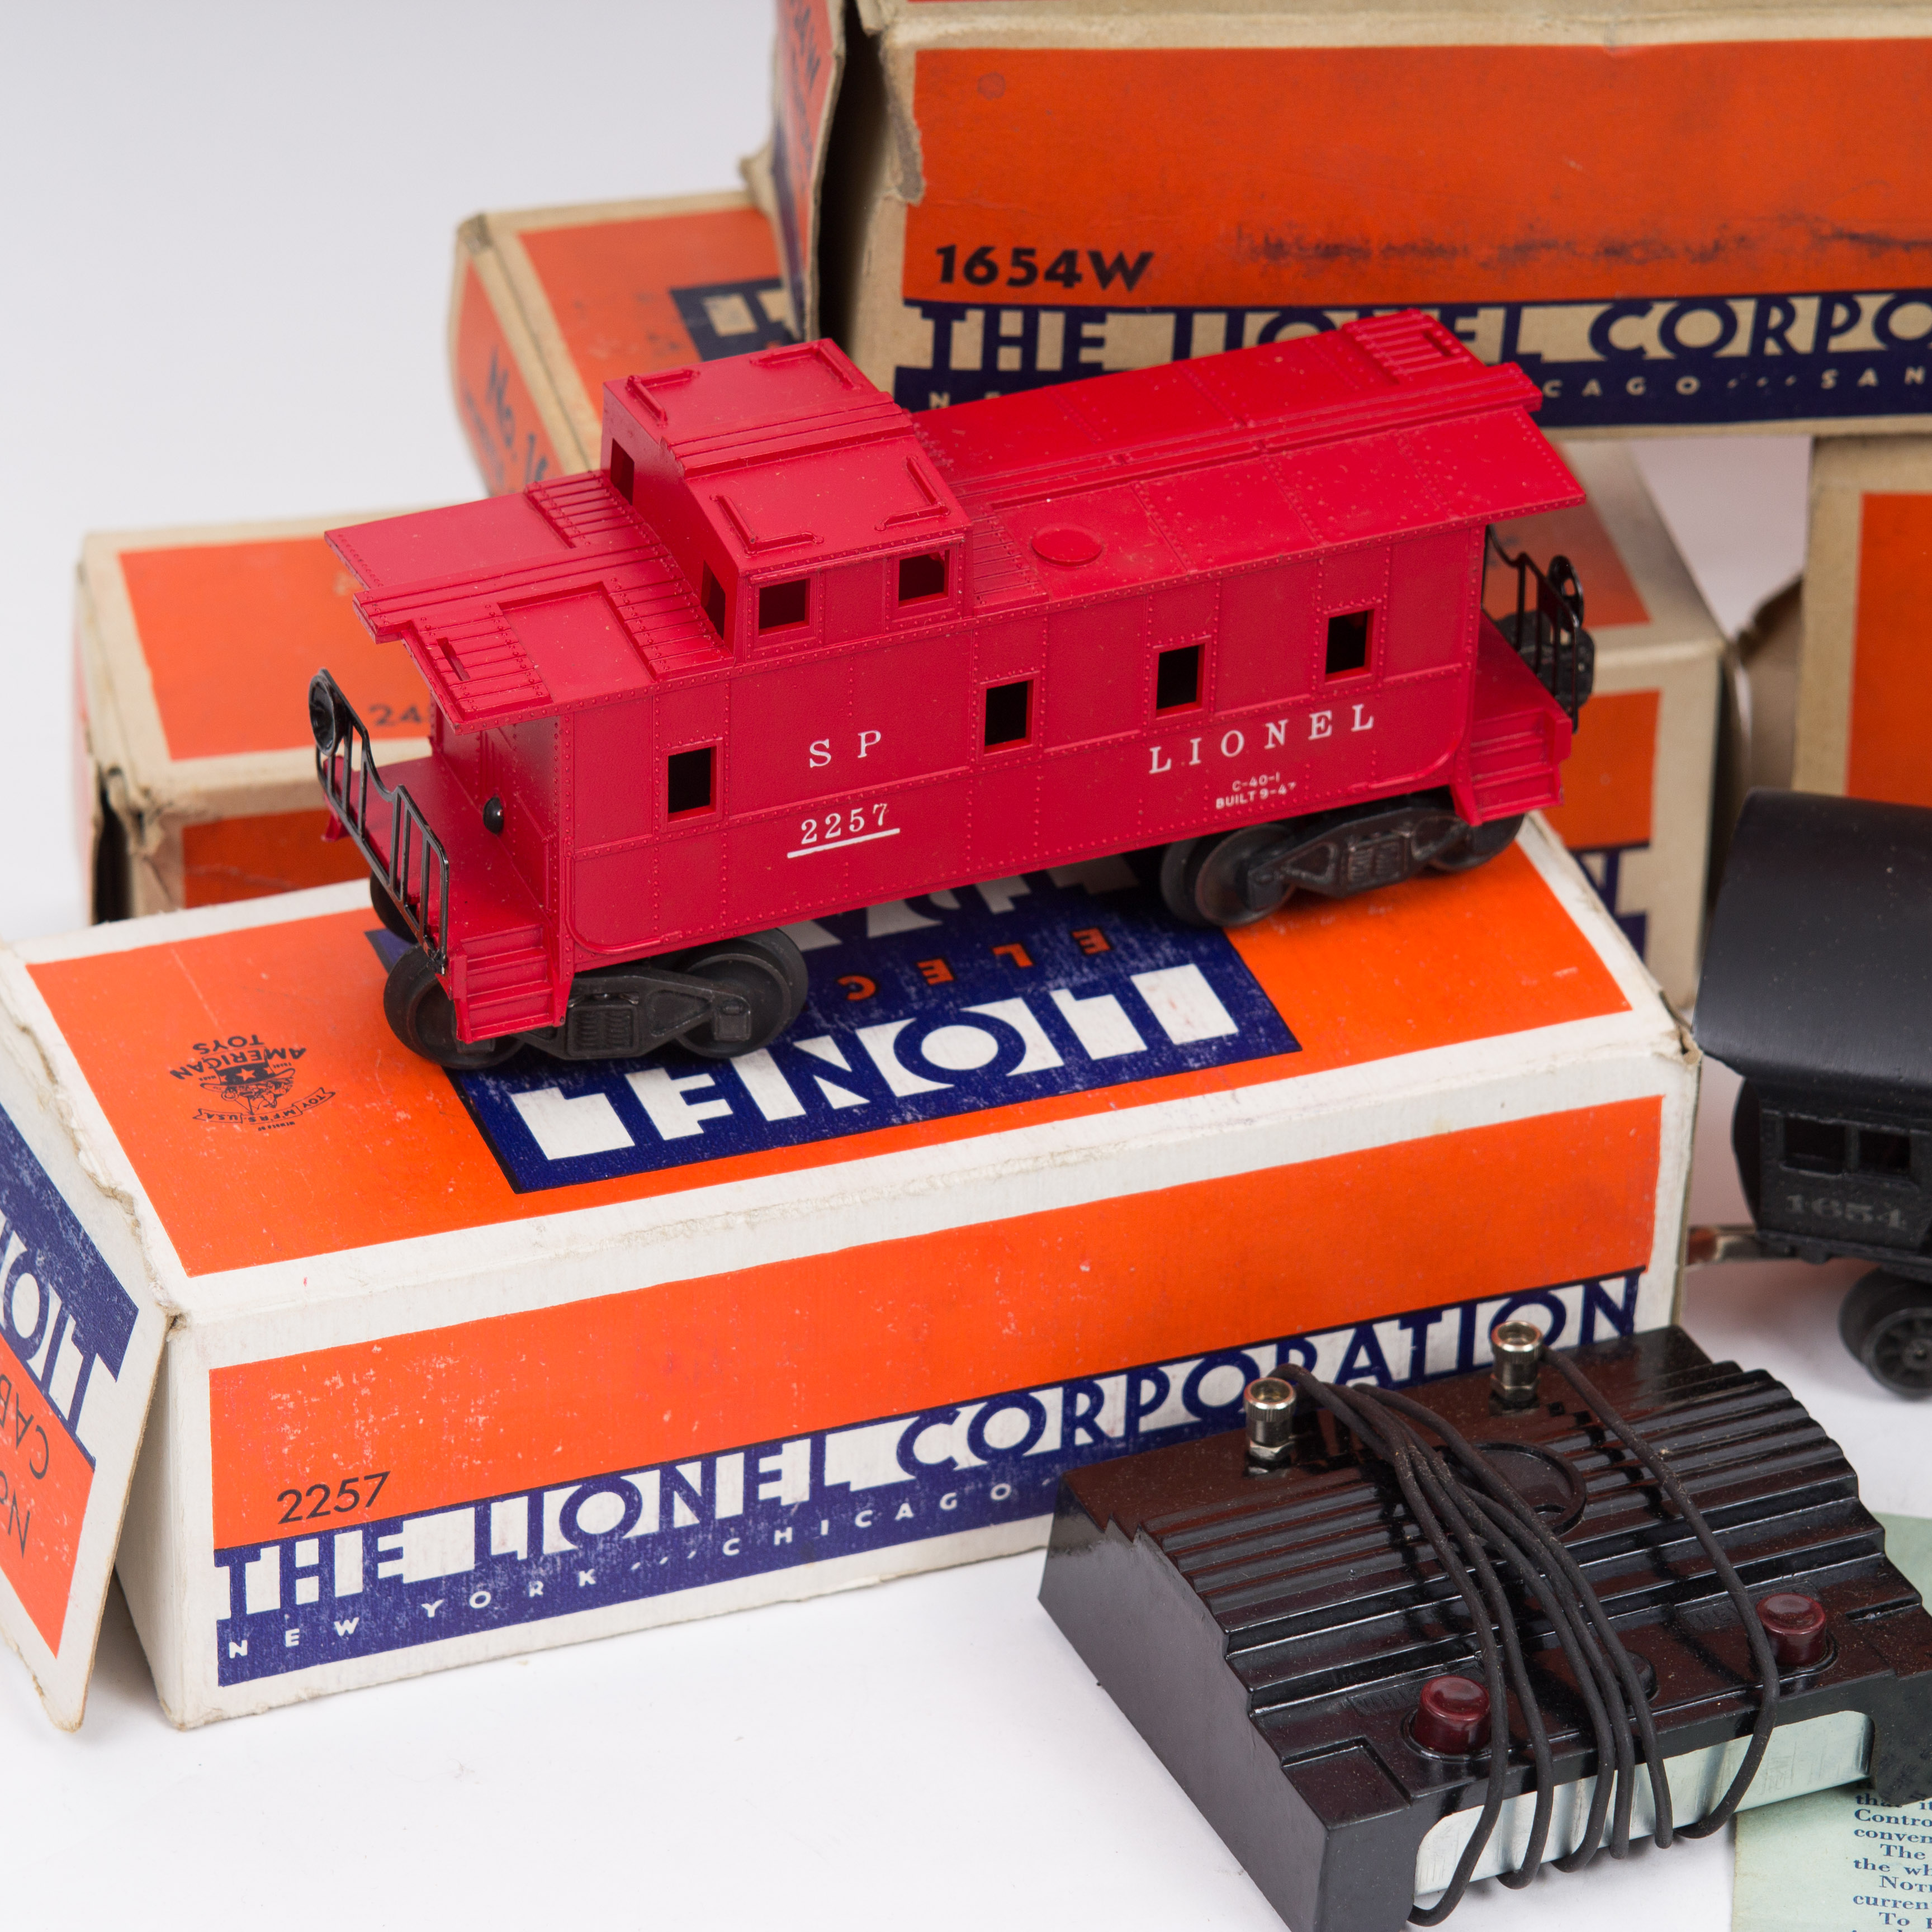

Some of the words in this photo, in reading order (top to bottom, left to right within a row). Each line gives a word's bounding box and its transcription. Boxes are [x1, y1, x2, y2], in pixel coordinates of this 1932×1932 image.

[936, 244, 1154, 292] 1654W
[920, 304, 1107, 372] THE
[1149, 704, 1374, 774] LIONEL
[1215, 790, 1256, 810] BUILT
[801, 803, 887, 845] 2257
[193, 1034, 265, 1054] TOYS
[559, 970, 1191, 1149] LIONEL
[169, 1047, 307, 1079] AMERICAN
[301, 1094, 326, 1109] TOY
[277, 1470, 391, 1525] 2257
[215, 1522, 404, 1617] THE
[474, 1432, 851, 1572] LIONEL
[229, 1617, 359, 1659] NEW
[422, 1569, 596, 1618] YORK
[722, 1483, 1012, 1556] CHICAGO
[1853, 1858, 1890, 1872] the
[1880, 1844, 1926, 1860] The
[1853, 1895, 1932, 1910] curren
[1879, 1912, 1910, 1926] To
